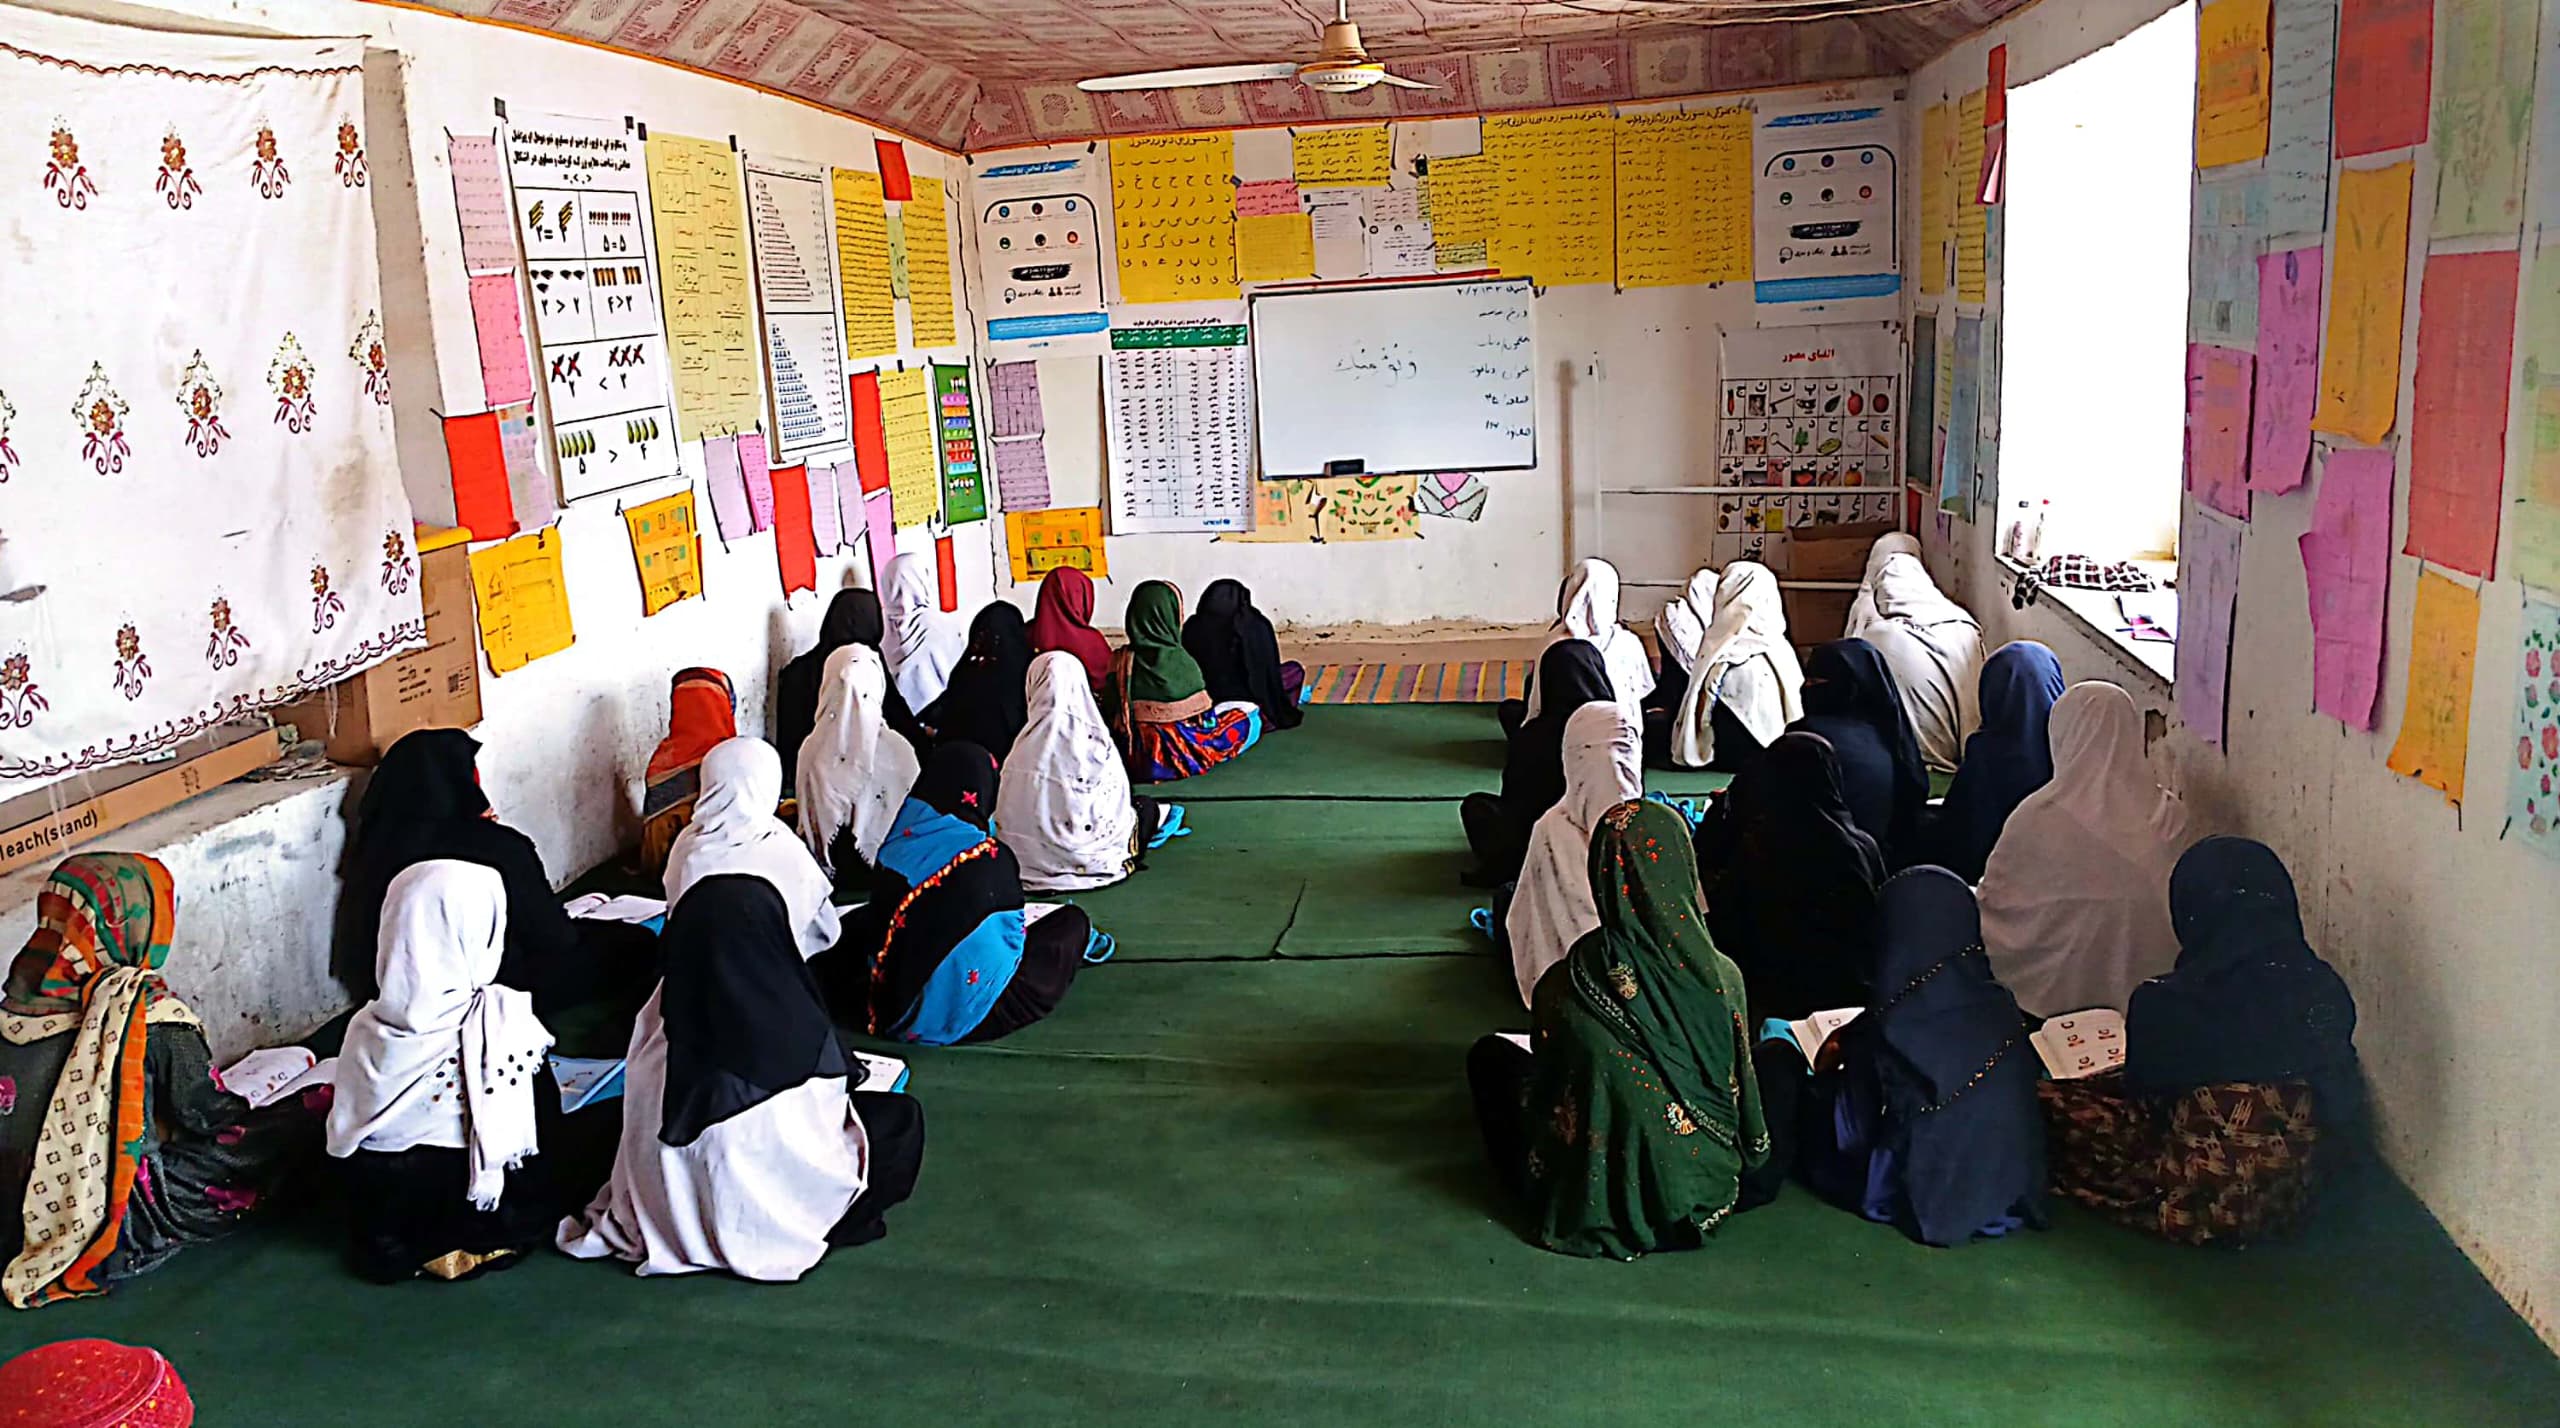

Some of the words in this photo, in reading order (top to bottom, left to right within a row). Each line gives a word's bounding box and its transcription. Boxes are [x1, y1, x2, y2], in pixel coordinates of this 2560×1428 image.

[603, 234, 610, 252] ۵
[620, 234, 626, 252] ۵
[1736, 386, 1746, 398] ج
[1857, 420, 1868, 432] ح
[579, 457, 586, 475] ۵
[1755, 456, 1766, 467] ط
[1799, 459, 1816, 472] ص
[1731, 495, 1743, 512] ل
[1878, 496, 1887, 511] ع
